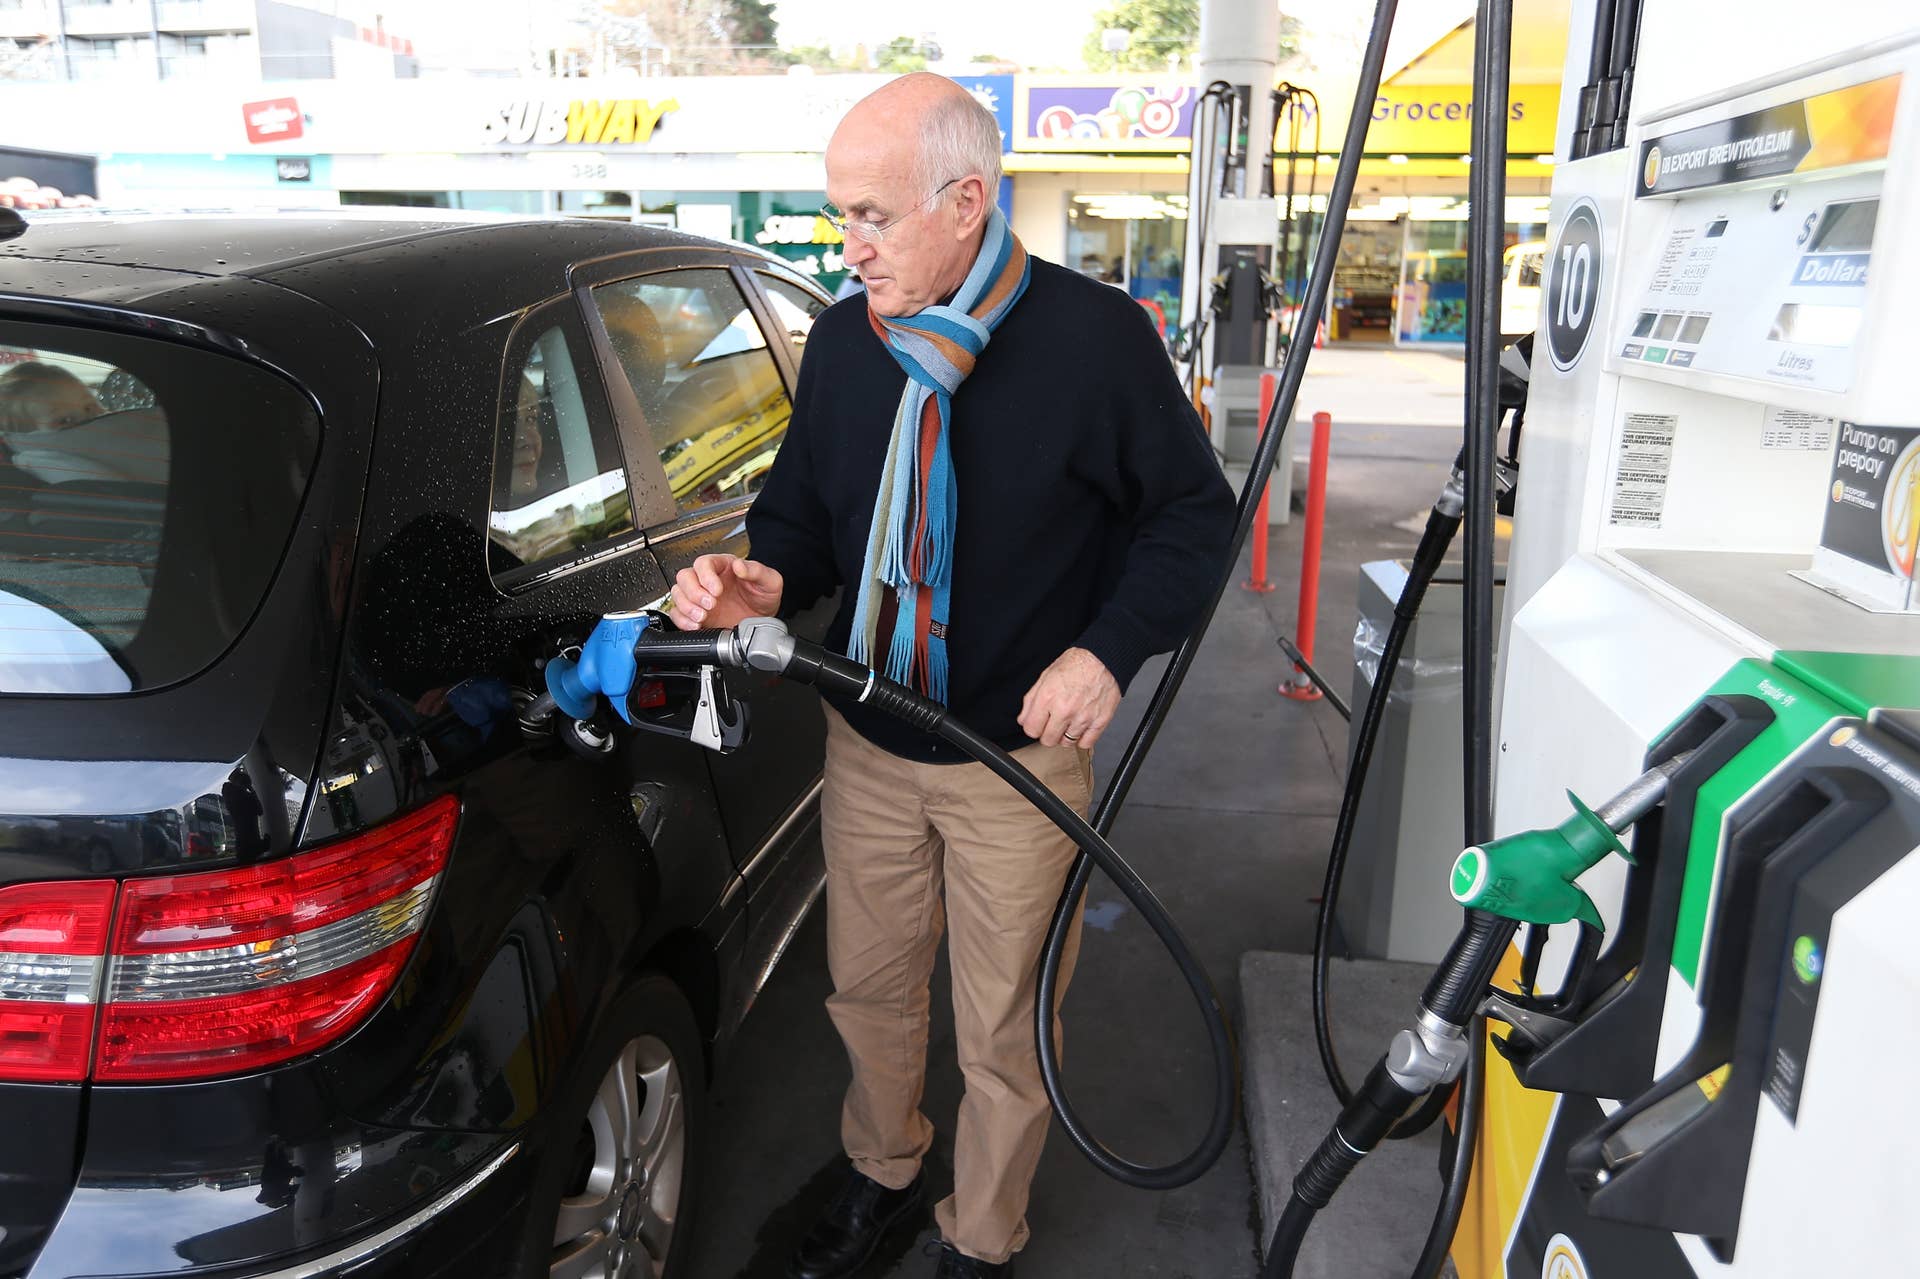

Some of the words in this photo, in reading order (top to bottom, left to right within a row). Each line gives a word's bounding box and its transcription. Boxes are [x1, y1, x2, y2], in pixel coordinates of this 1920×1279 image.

[481, 98, 680, 144] SUBWAY
[1371, 97, 1524, 121] Grocers
[1671, 148, 1708, 172] EXPORT
[1708, 130, 1793, 164] BREWTROLEUM
[1562, 243, 1590, 330] 10
[1777, 350, 1813, 371] Litres
[1842, 423, 1877, 453] Pump
[1878, 437, 1895, 455] on
[1837, 449, 1885, 479] prepay
